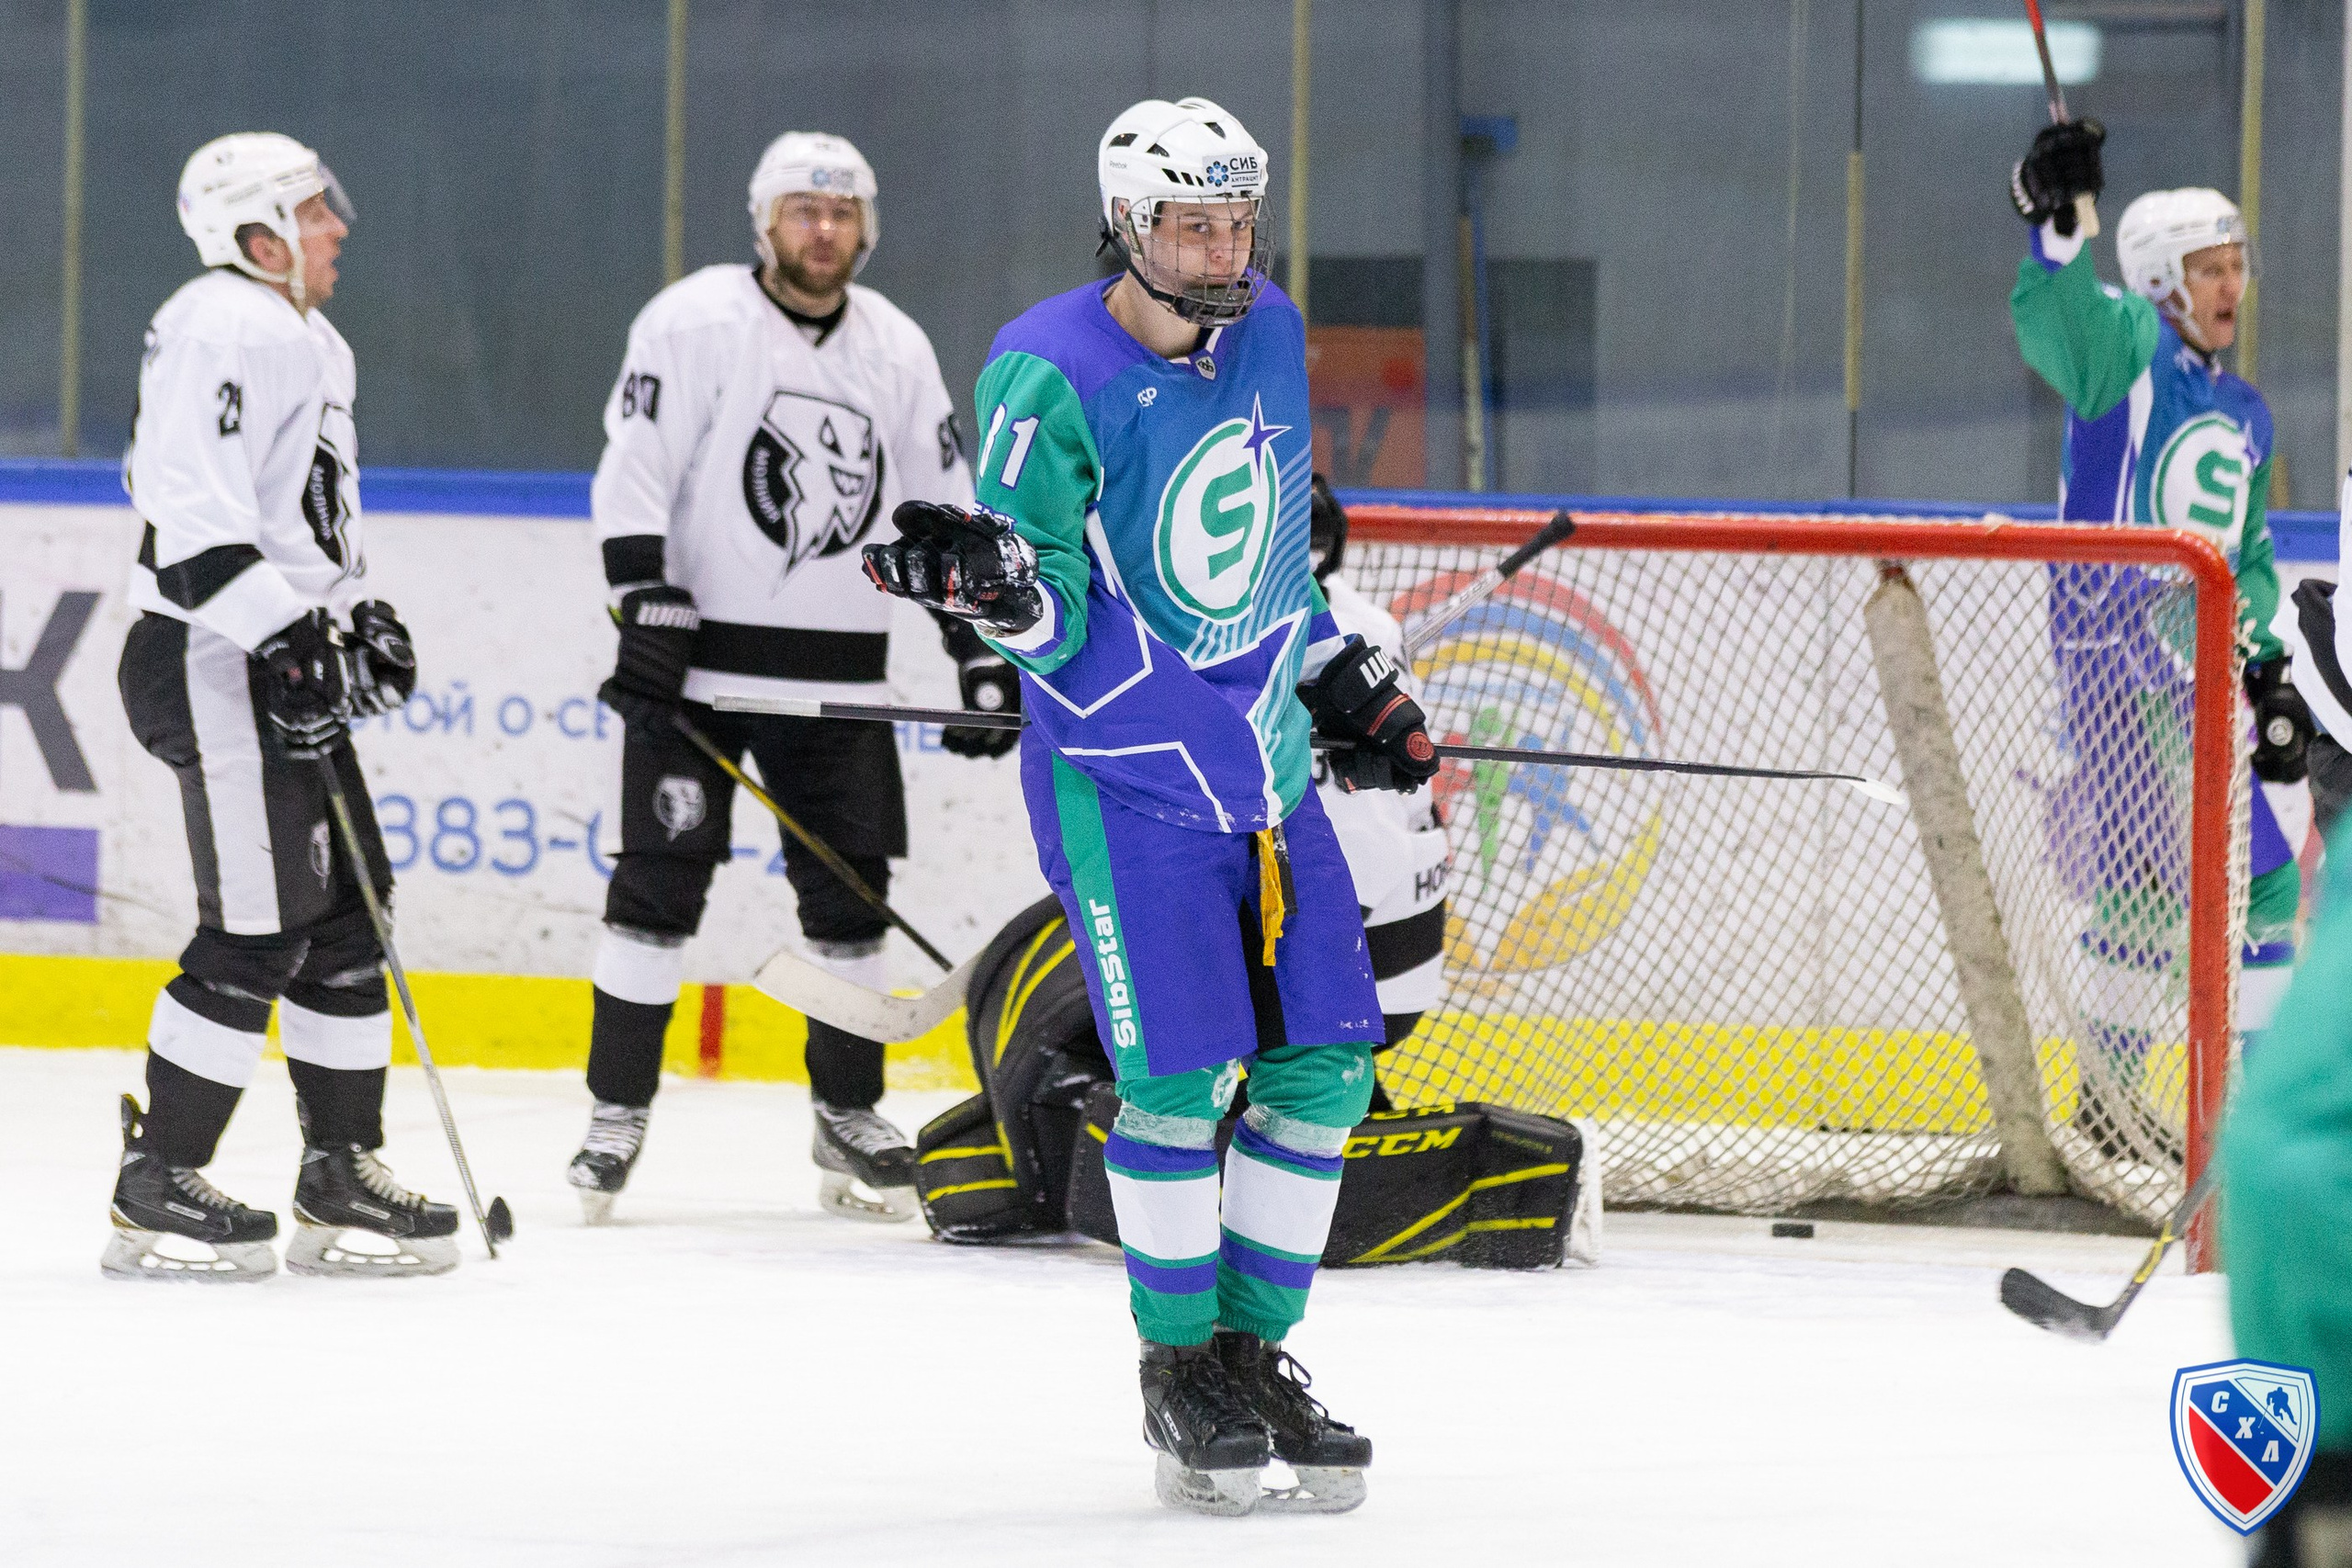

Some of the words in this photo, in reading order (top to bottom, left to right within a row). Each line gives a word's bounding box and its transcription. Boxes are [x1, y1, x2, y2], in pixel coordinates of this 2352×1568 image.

[1229, 156, 1258, 171] СИБ
[1231, 175, 1259, 183] АНТРАЦИТ
[1200, 461, 1256, 581] S
[1088, 898, 1136, 1049] SibStar
[1342, 1126, 1463, 1159] CCM
